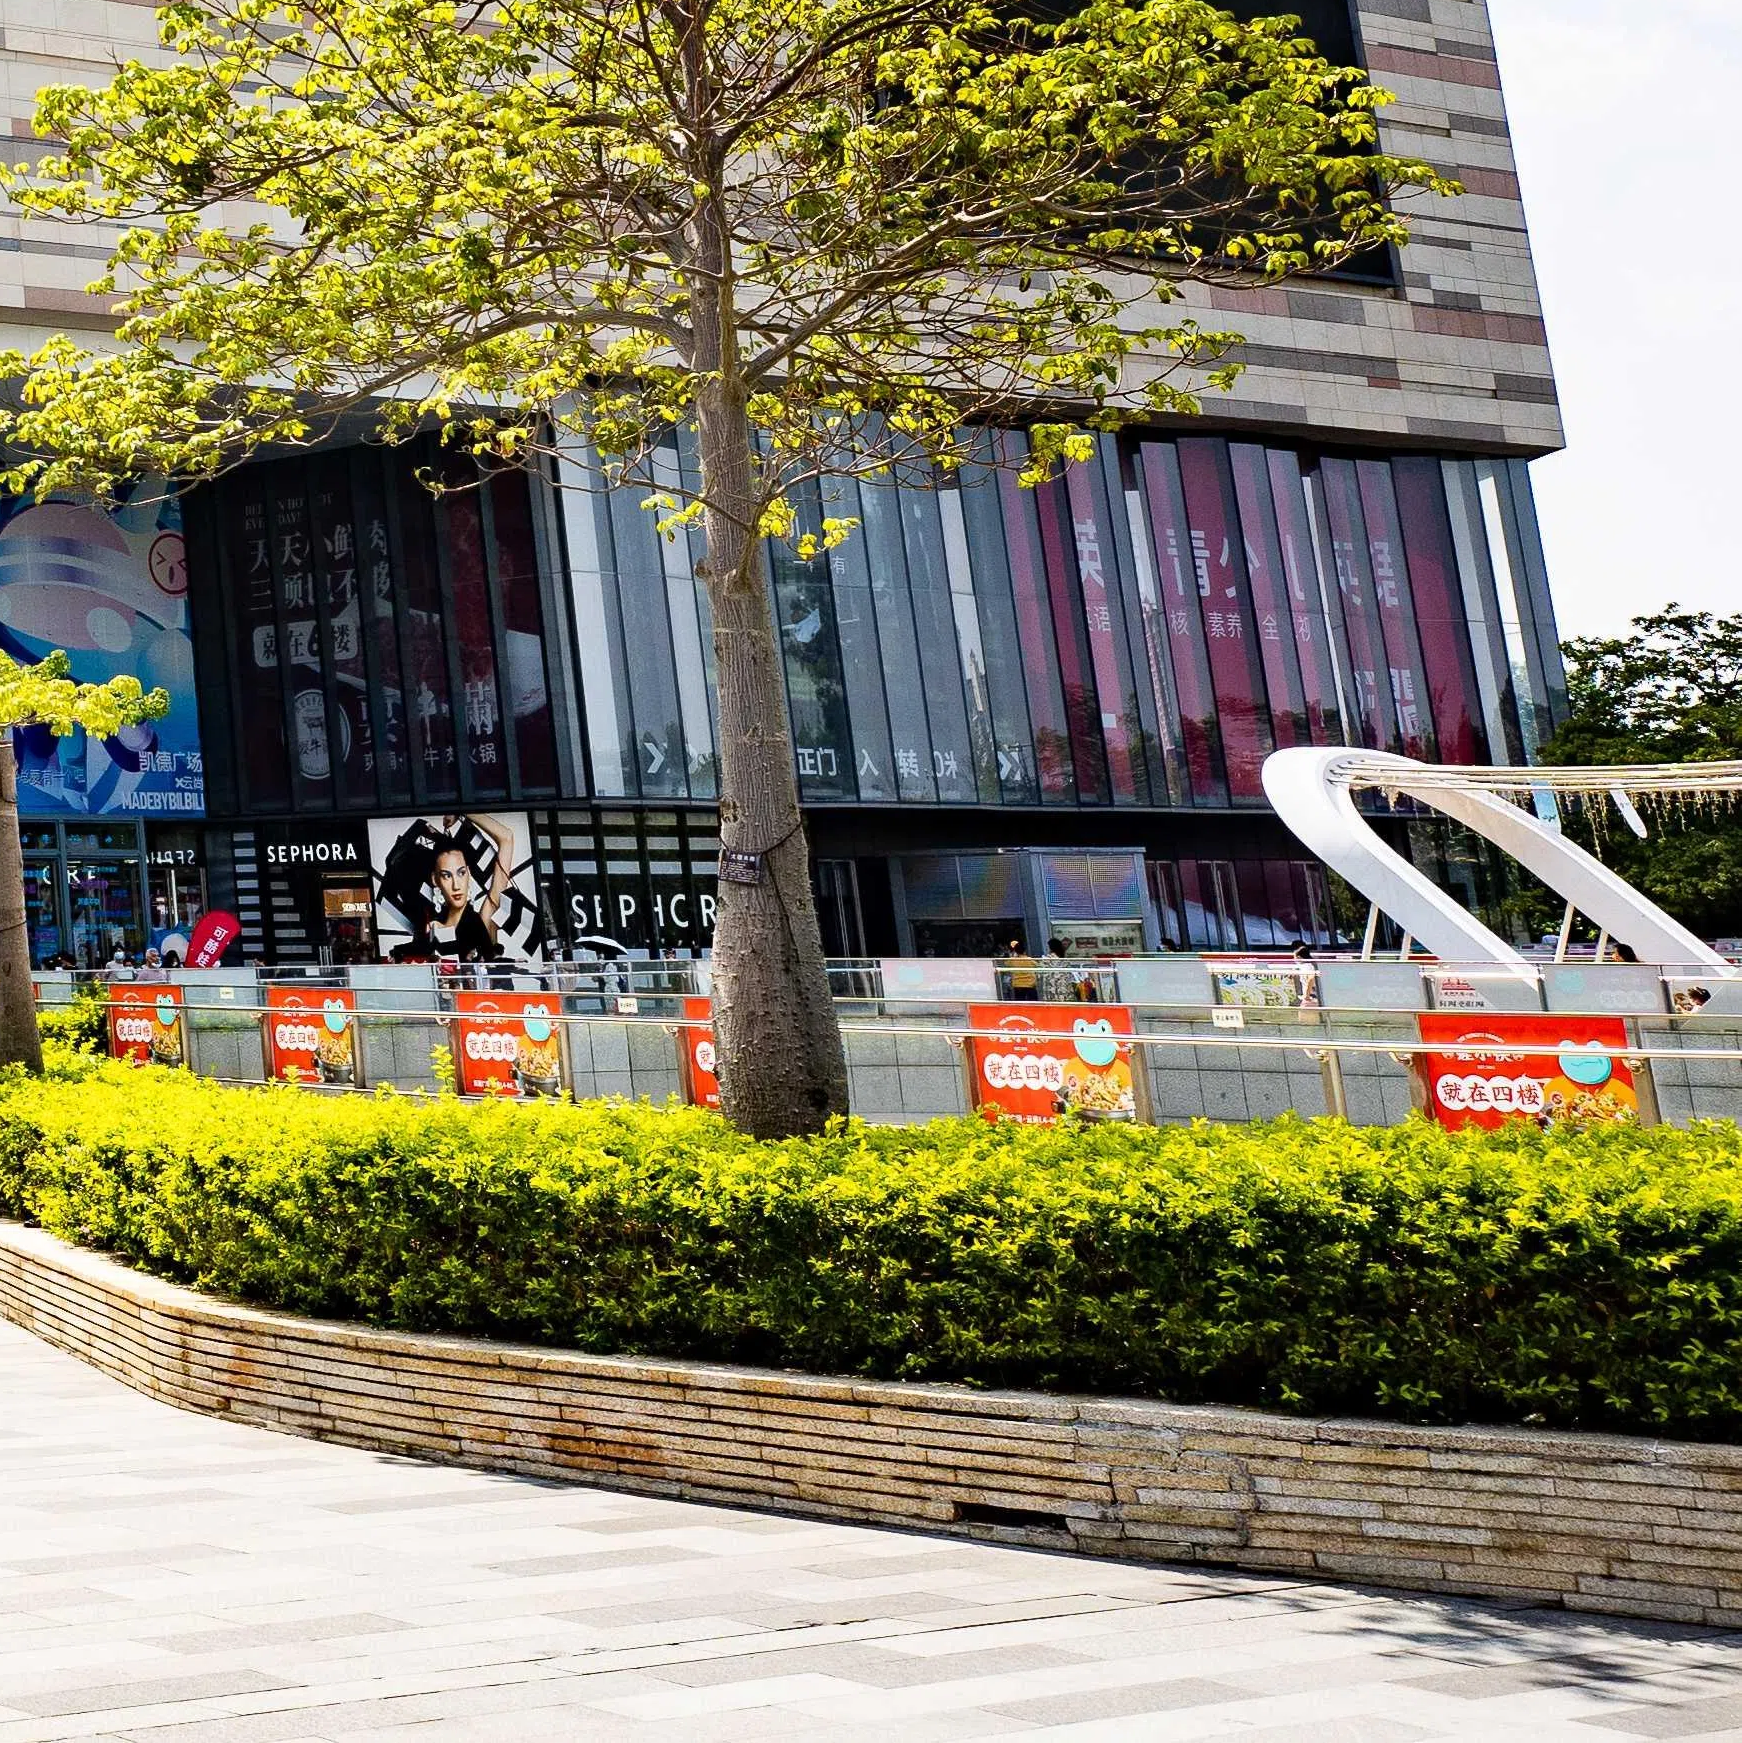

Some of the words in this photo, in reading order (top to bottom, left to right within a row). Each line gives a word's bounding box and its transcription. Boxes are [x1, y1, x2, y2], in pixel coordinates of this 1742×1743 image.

[138, 751, 203, 773] 凯德广场
[266, 843, 358, 863] SEPHORA
[988, 1060, 1060, 1084] 就在四楼
[1441, 1081, 1540, 1107] 就在四楼
